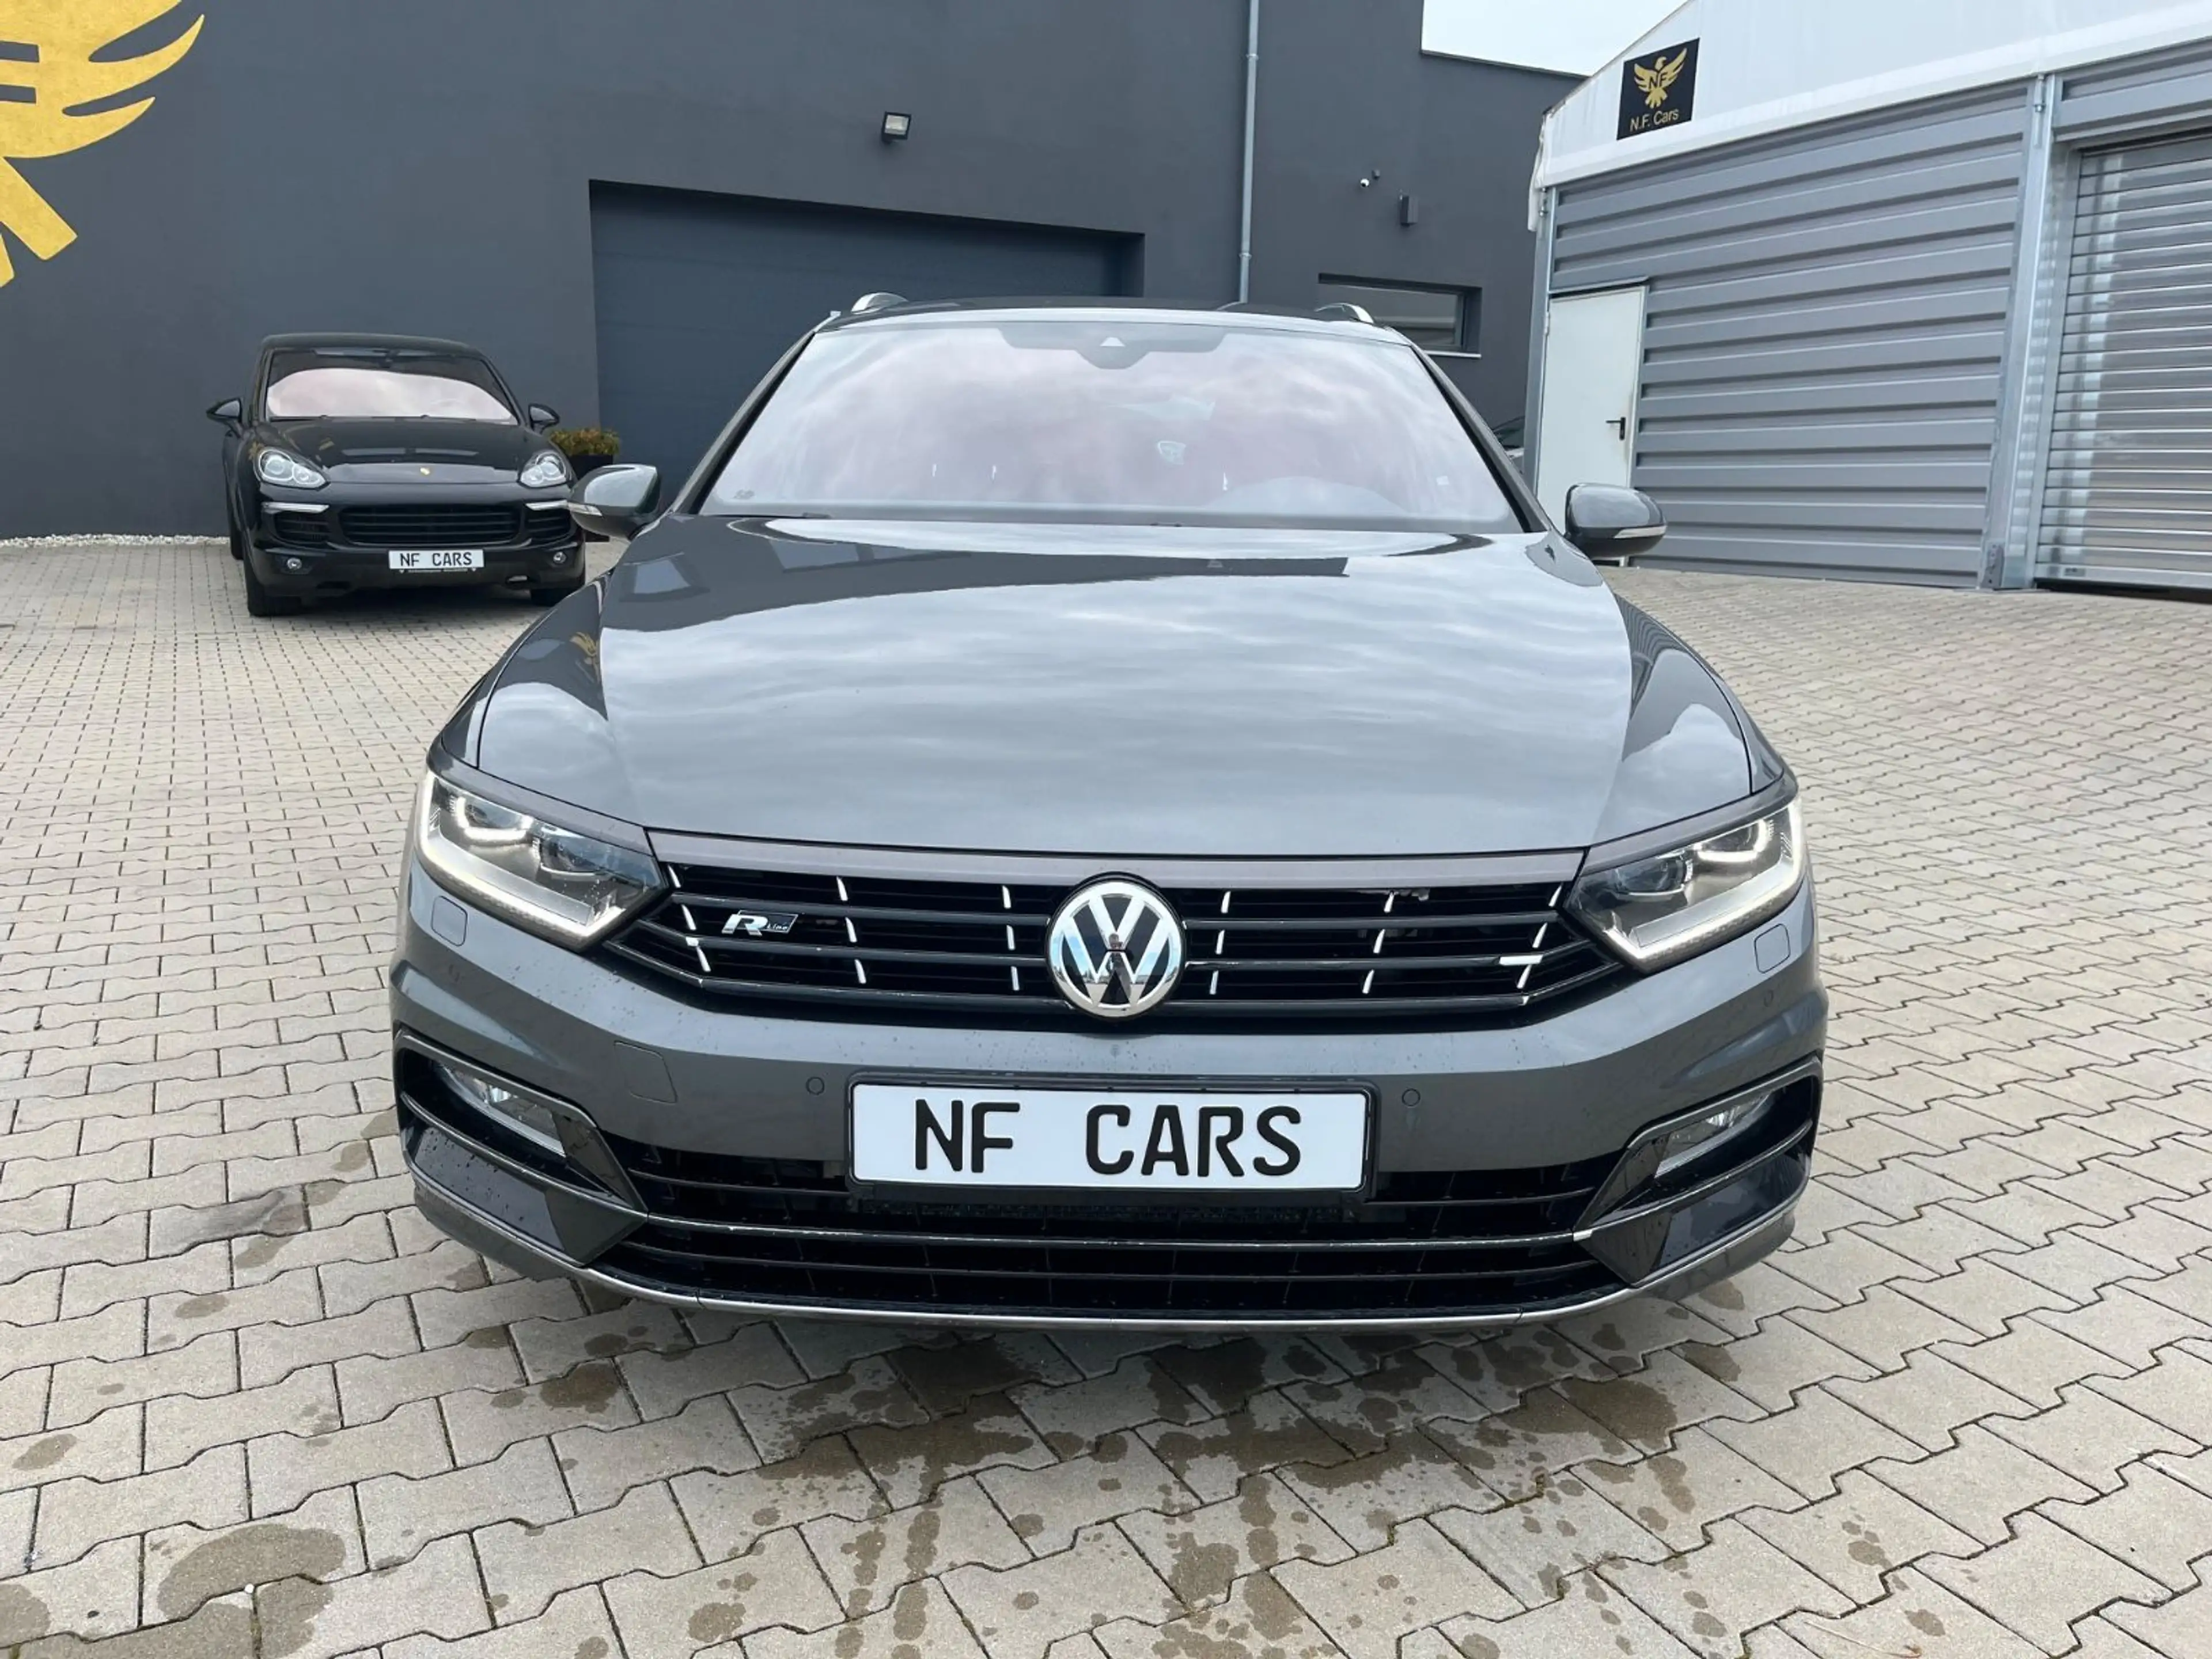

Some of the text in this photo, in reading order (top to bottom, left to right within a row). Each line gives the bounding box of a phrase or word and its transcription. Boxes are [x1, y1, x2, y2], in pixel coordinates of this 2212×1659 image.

[1630, 109, 1679, 132] N.F. Cars
[400, 552, 472, 567] NF CARS
[721, 914, 768, 936] R
[915, 1099, 1302, 1177] NF CARS
